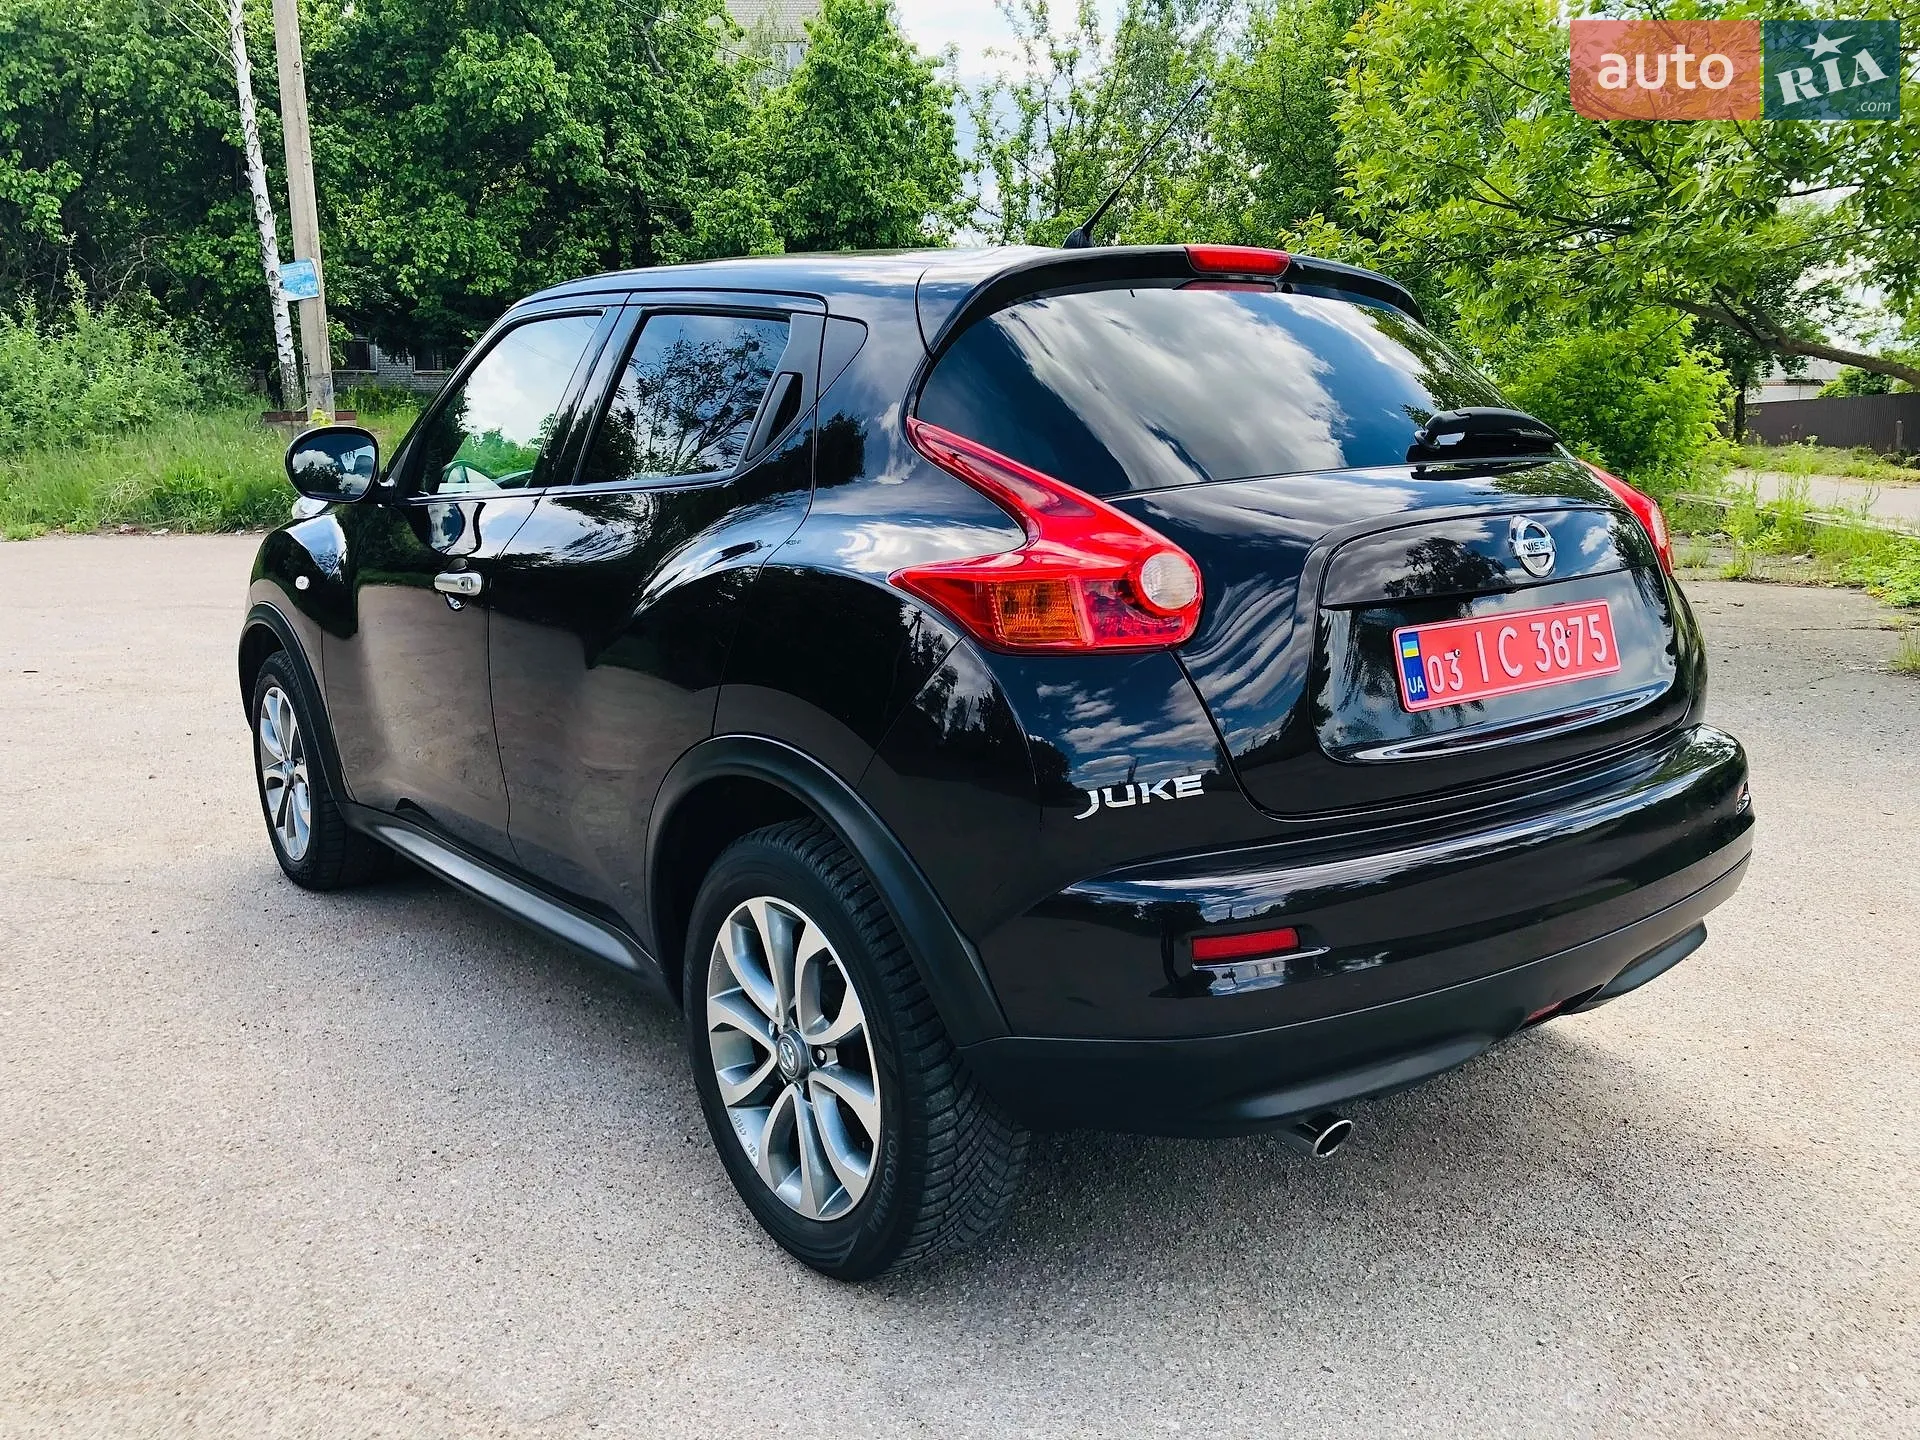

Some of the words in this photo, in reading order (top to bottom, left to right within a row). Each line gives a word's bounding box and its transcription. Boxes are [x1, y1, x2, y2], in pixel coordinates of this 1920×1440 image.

[1408, 676, 1426, 694] UA
[1427, 651, 1464, 694] 03
[1530, 613, 1608, 672] 3875
[1073, 773, 1205, 820] JUKE
[866, 1128, 899, 1233] YOKOHAMA
